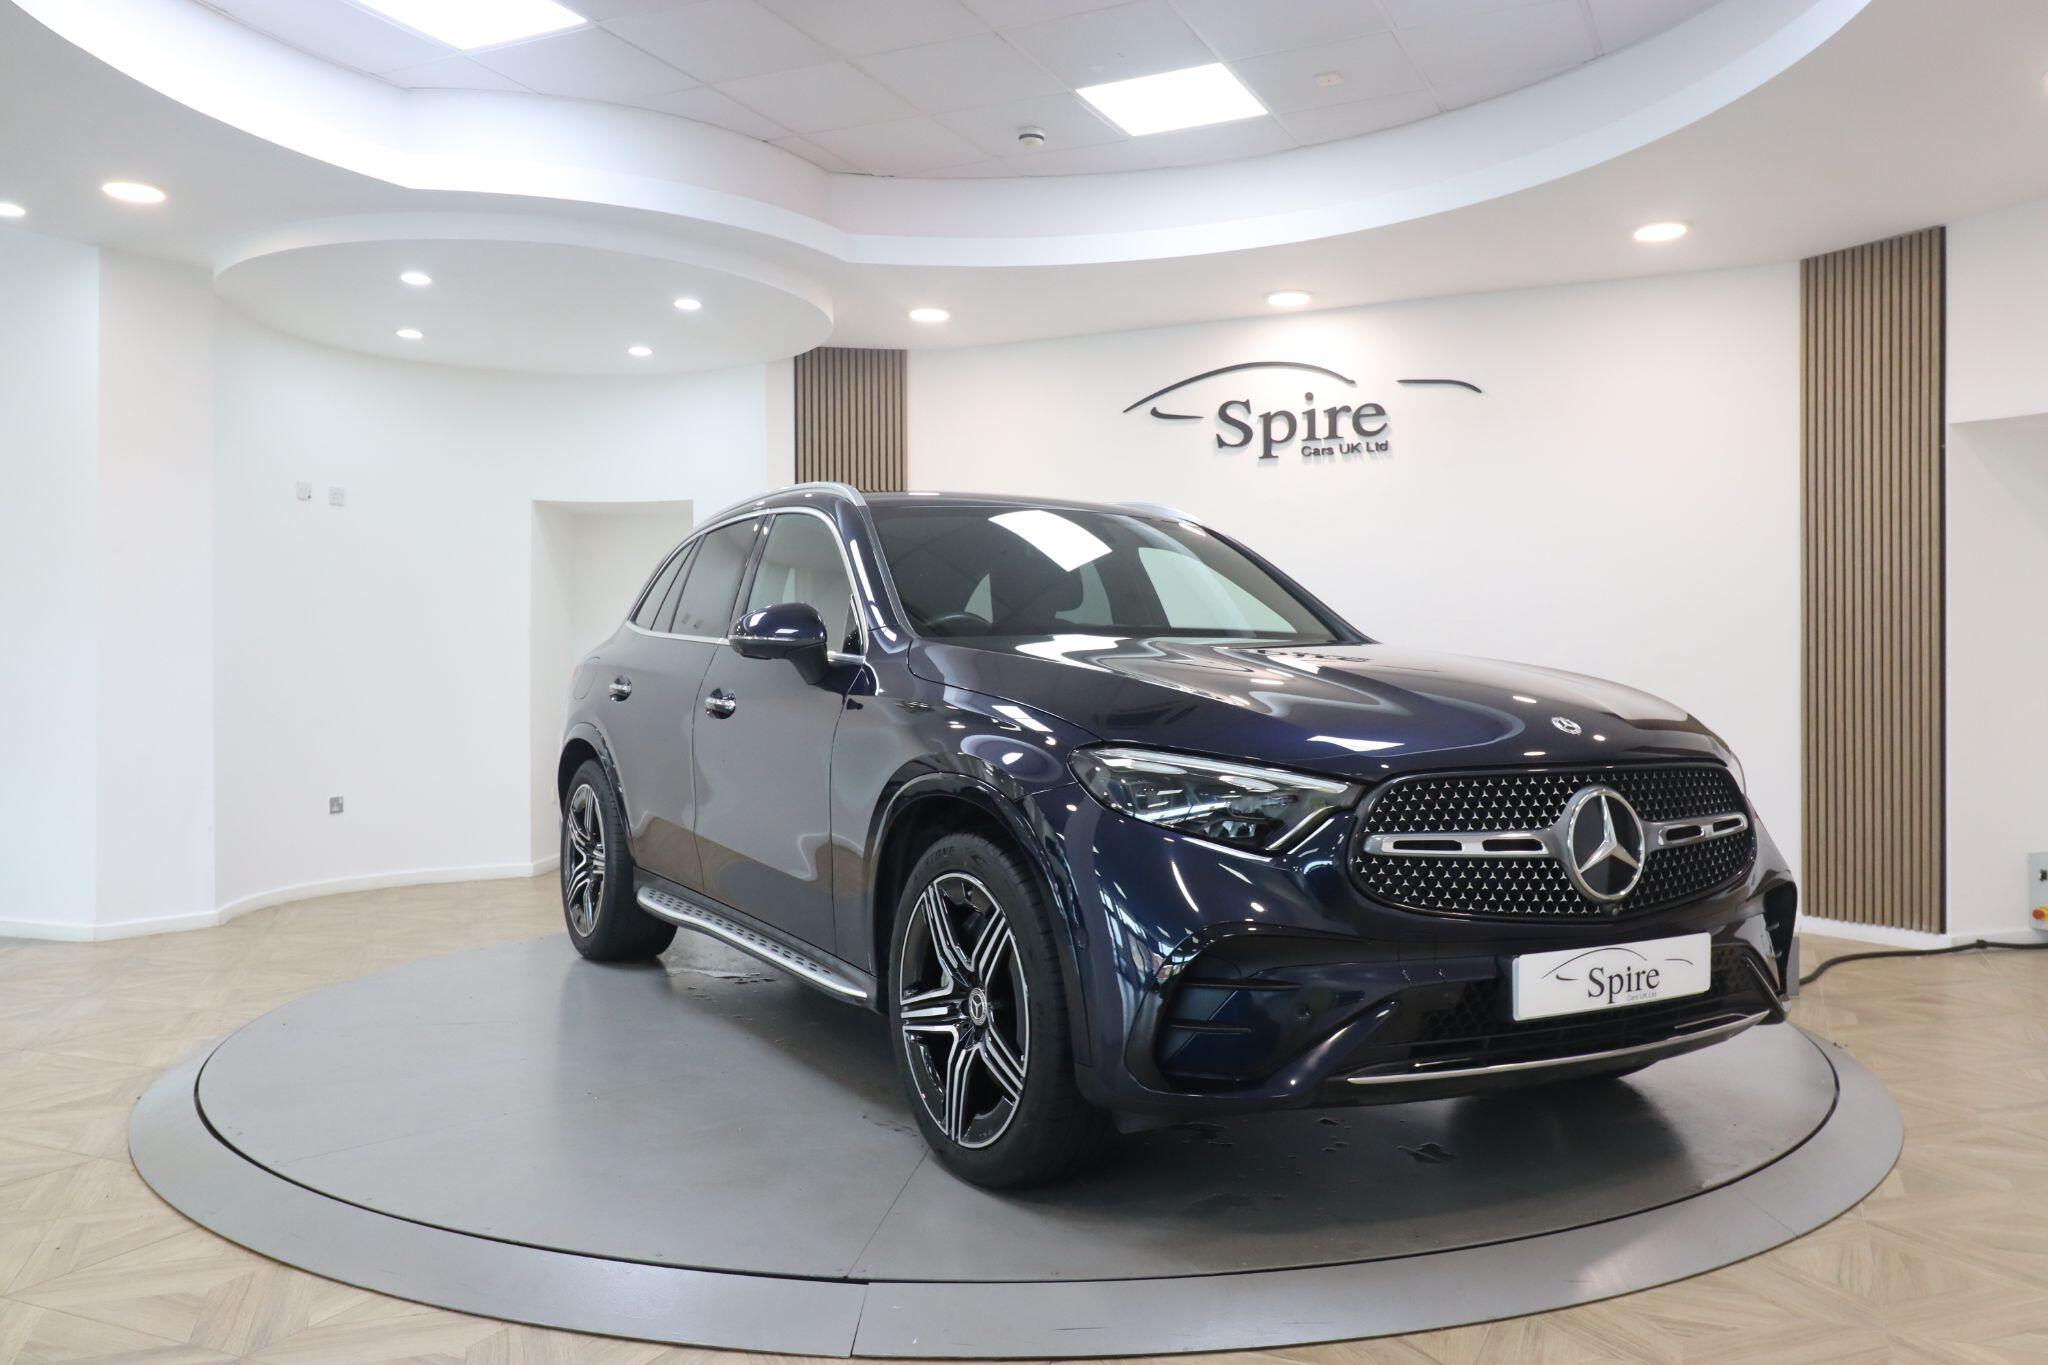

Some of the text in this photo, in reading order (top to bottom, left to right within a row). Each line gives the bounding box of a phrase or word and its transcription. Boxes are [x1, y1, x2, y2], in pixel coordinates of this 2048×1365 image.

[1216, 391, 1388, 459] Spire
[1301, 440, 1389, 457] Cars UK Ltd
[1588, 966, 1660, 1004] Spire
